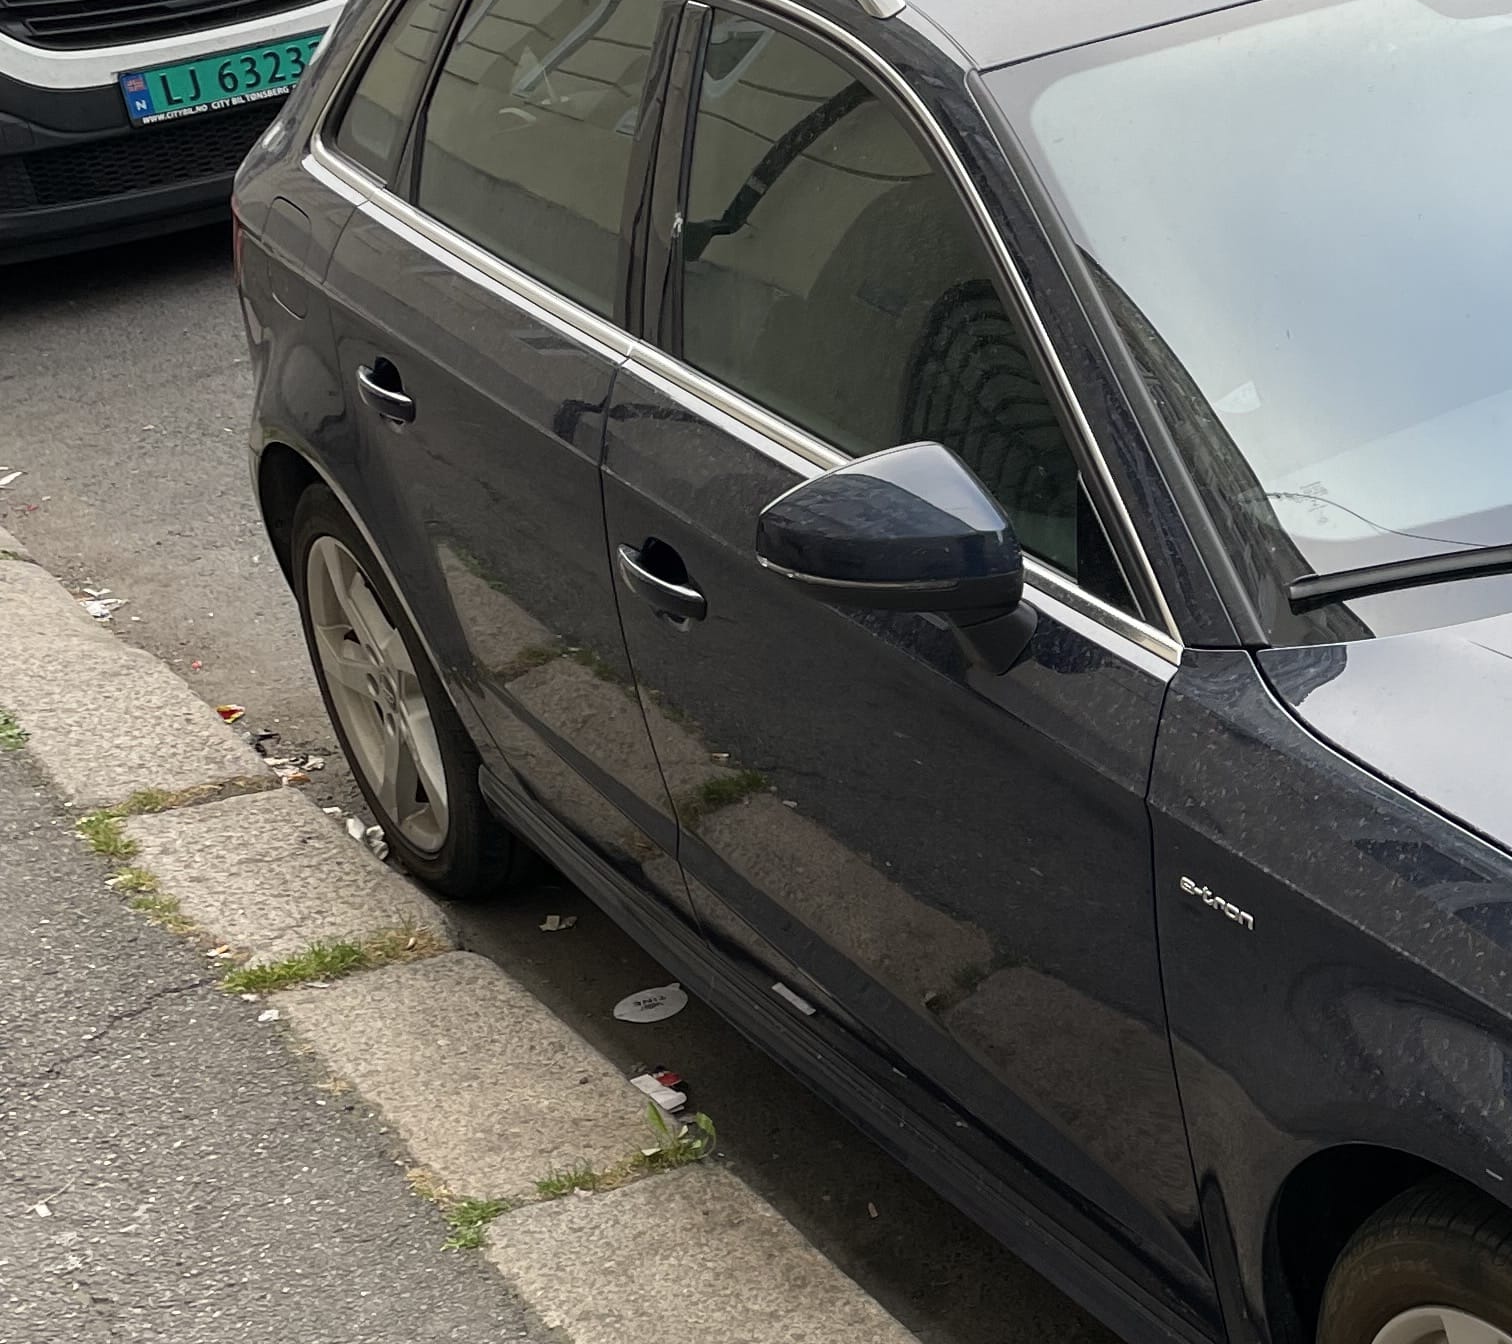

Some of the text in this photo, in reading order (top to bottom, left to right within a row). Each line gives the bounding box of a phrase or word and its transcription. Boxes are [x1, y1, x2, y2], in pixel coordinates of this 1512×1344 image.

[158, 39, 320, 106] LJ 6323
[135, 99, 147, 111] N
[210, 98, 230, 110] CITY
[231, 95, 246, 106] BIL
[245, 85, 290, 103] TØNSBERG
[1179, 875, 1255, 931] e-tron
